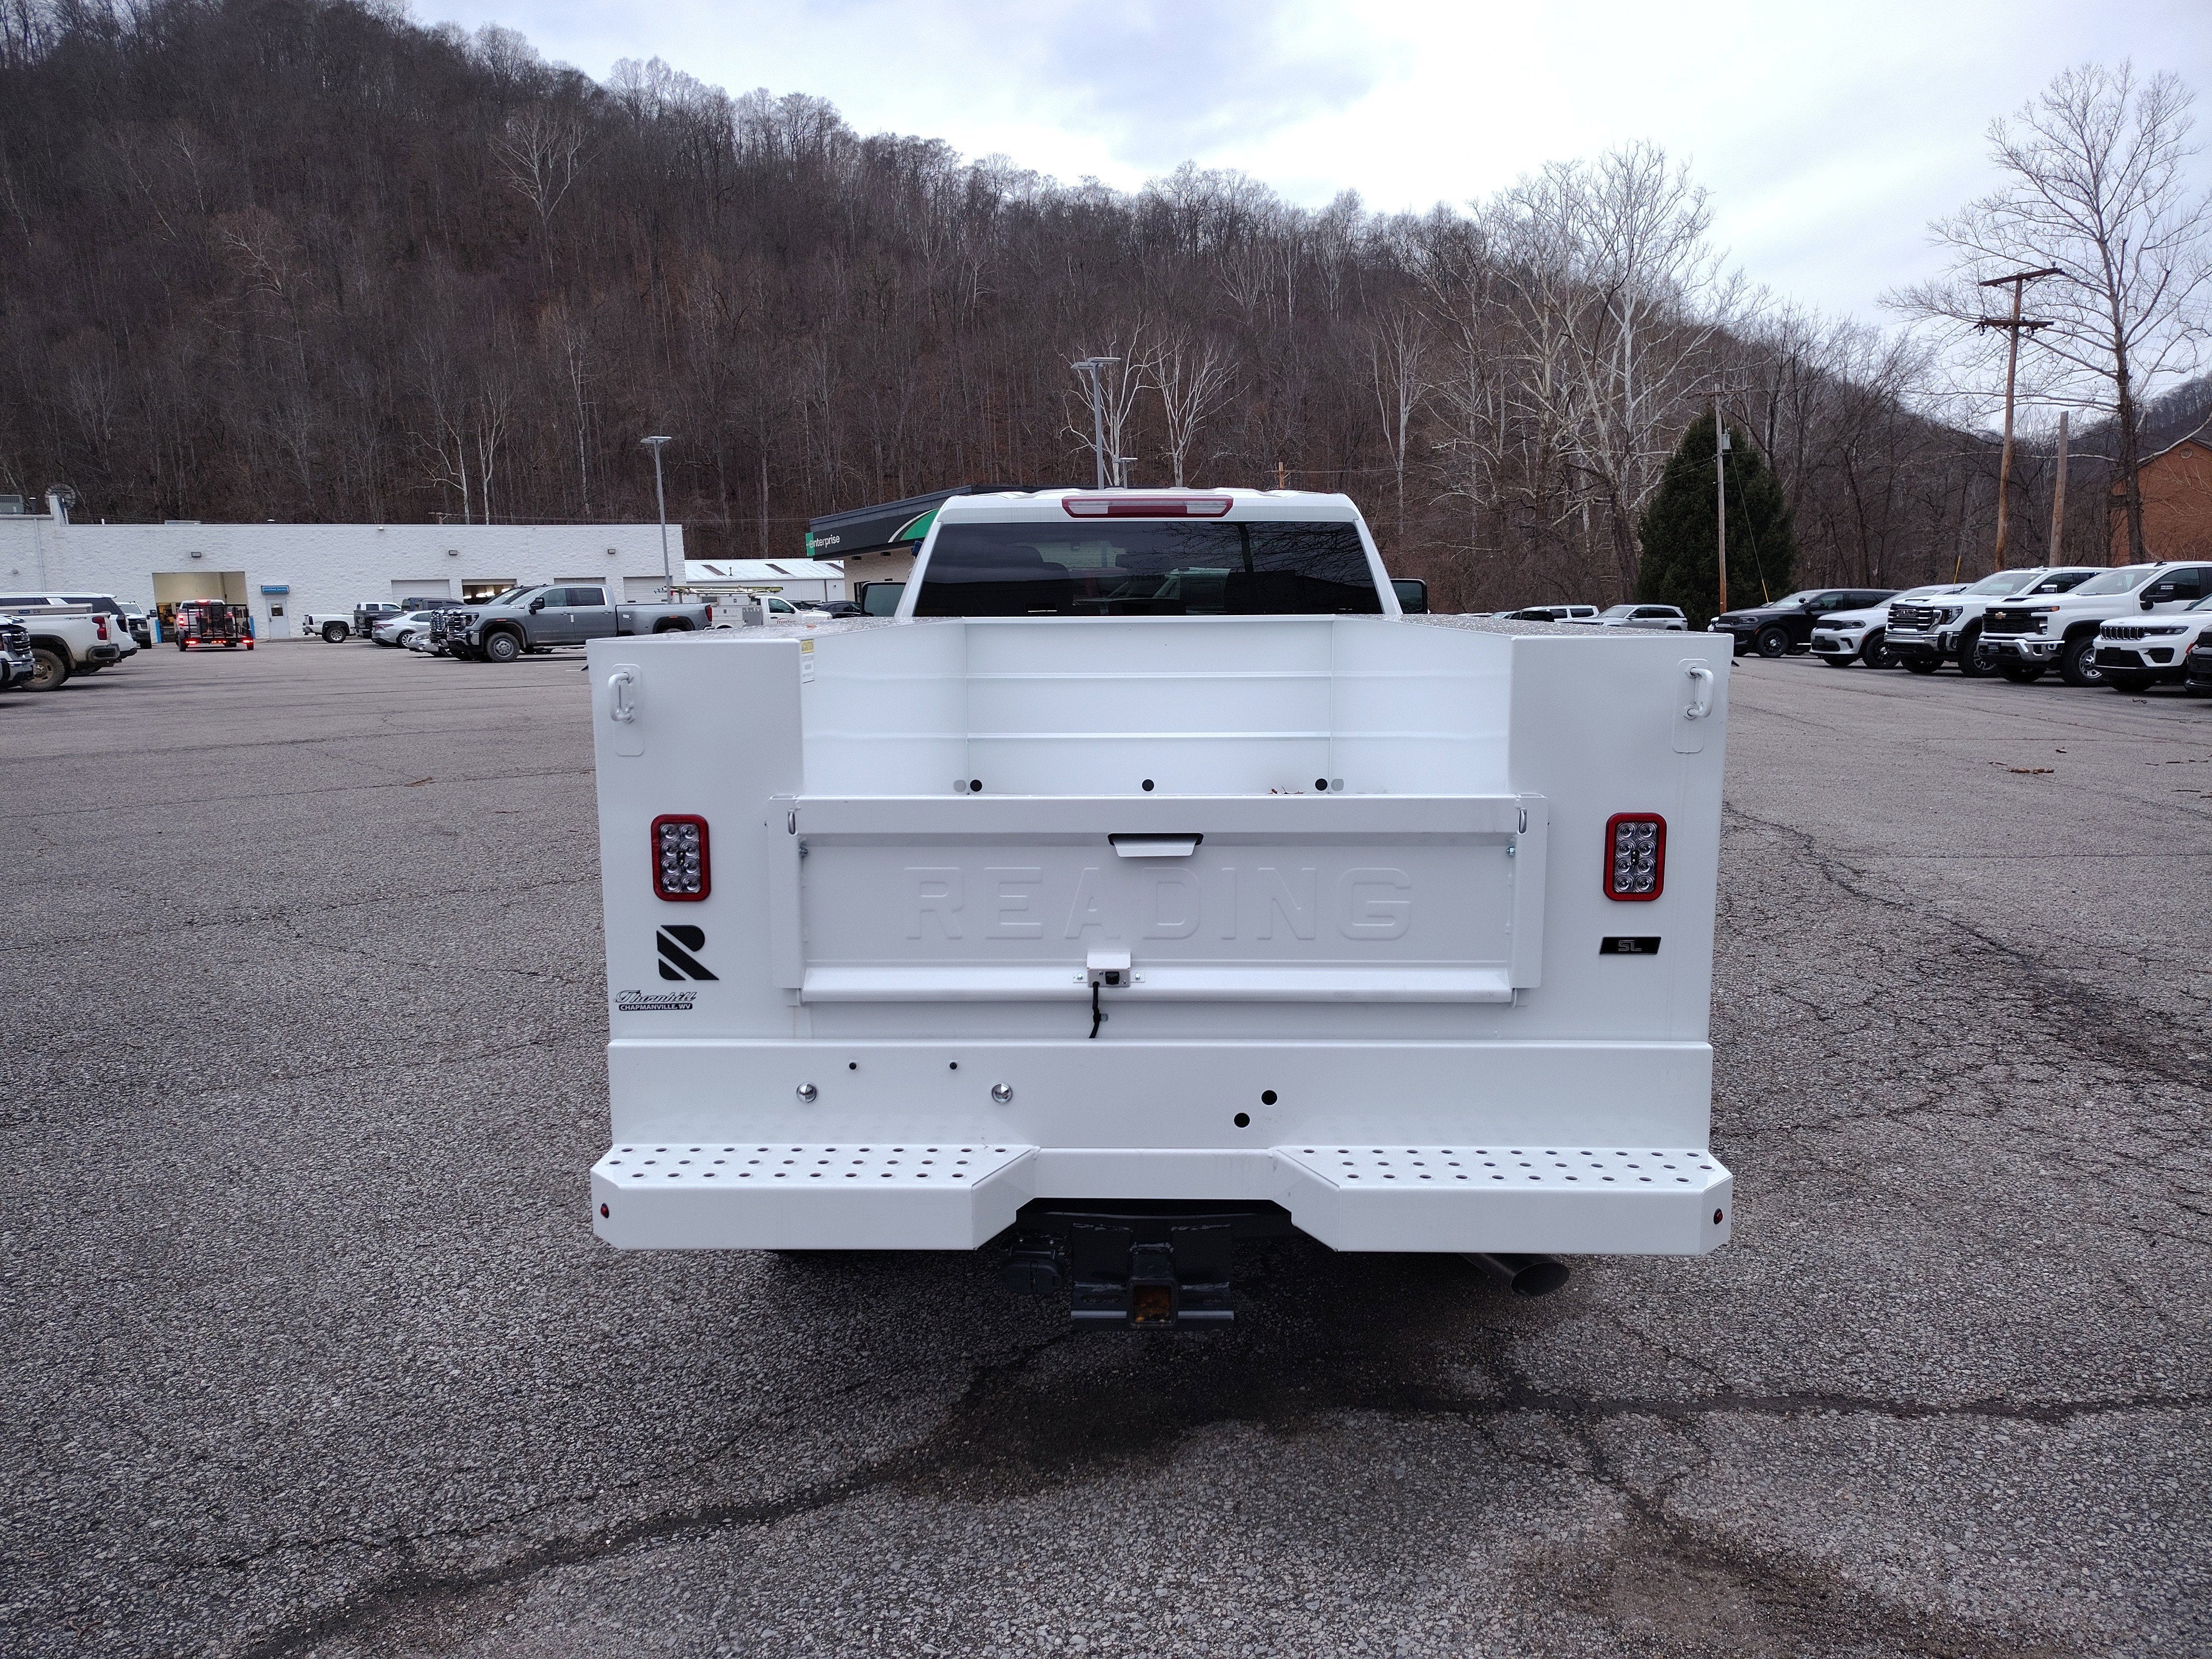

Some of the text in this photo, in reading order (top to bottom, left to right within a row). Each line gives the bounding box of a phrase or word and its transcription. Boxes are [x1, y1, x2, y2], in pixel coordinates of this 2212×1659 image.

[808, 534, 840, 548] enterprise
[905, 866, 1412, 941] READING
[1618, 940, 1642, 952] SL
[613, 989, 697, 1003] Thornhill
